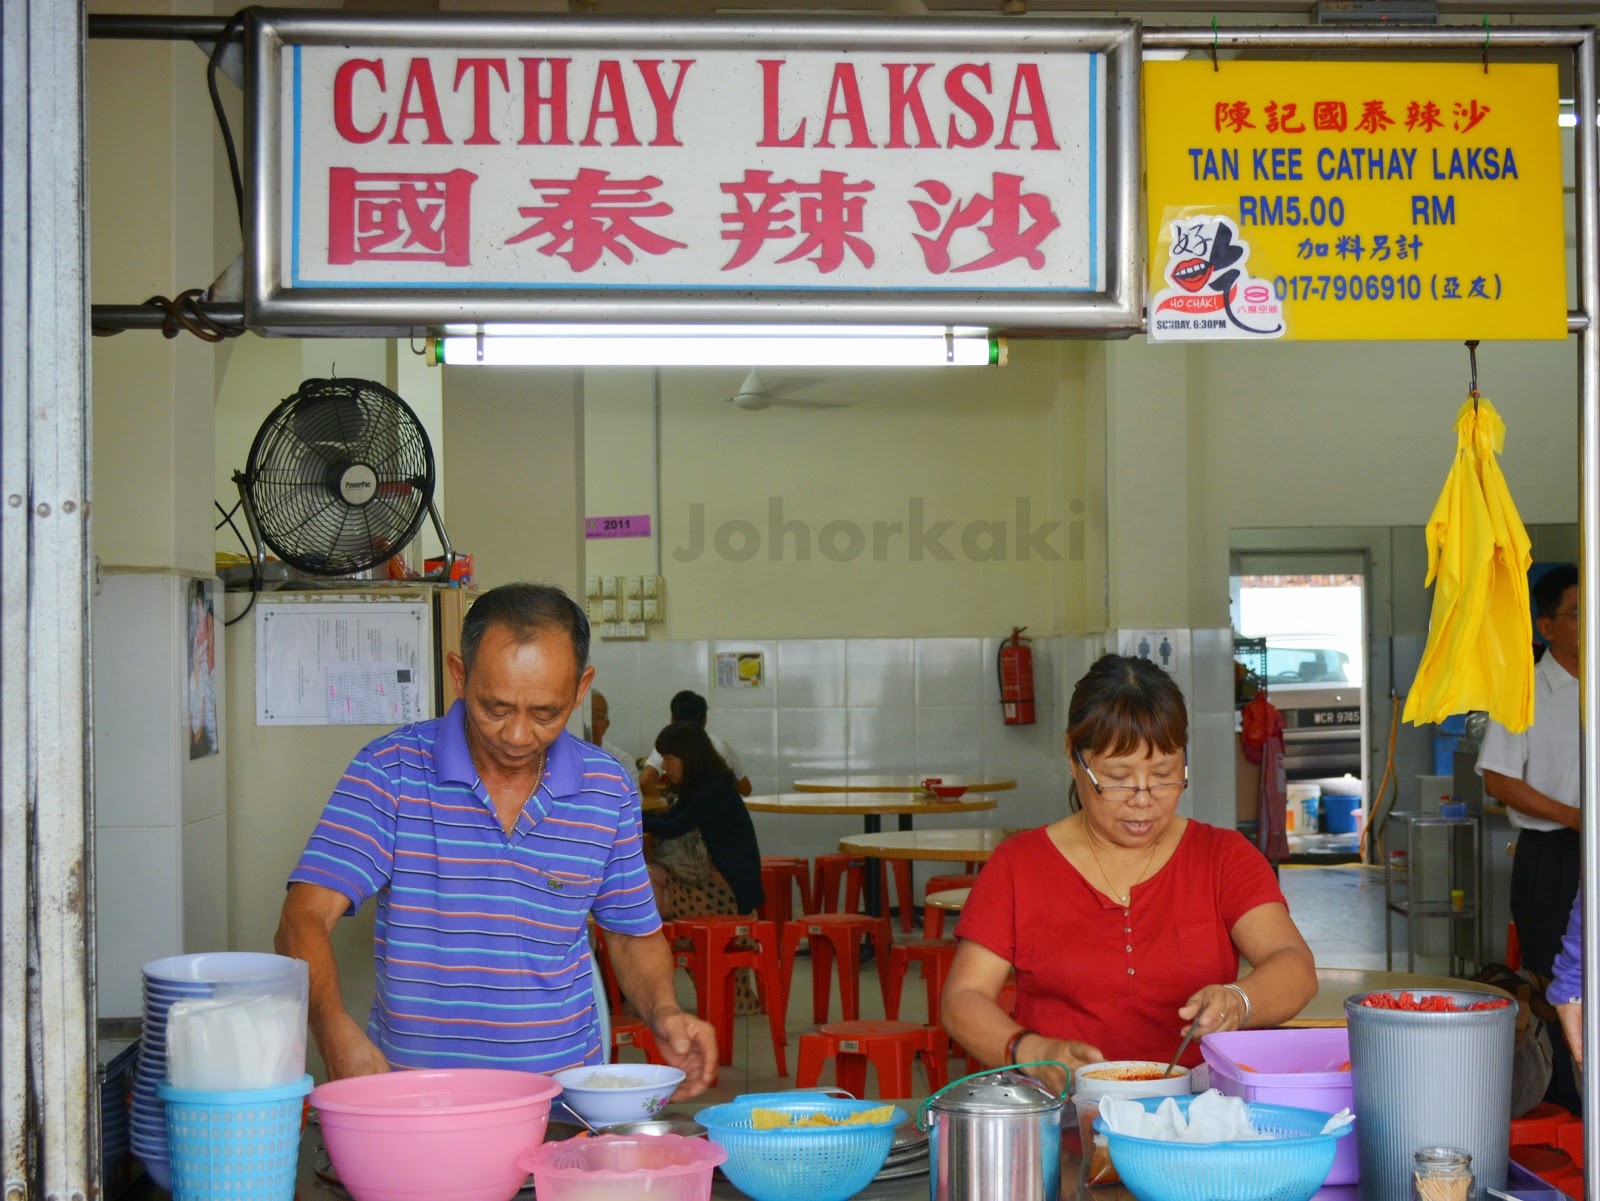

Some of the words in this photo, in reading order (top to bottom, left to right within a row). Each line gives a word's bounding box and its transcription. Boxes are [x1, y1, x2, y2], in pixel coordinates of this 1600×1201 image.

[333, 57, 696, 147] CATHAY
[756, 59, 1061, 150] LAKSA
[1215, 100, 1491, 134] 陳記國泰辣沙
[1189, 148, 1239, 181] TAN
[1254, 148, 1302, 181] KEE
[1317, 147, 1417, 181] CATHAY
[1433, 146, 1519, 180] LAKSA
[328, 166, 1061, 275] 國泰辣沙
[1239, 195, 1345, 227] RM5.00
[1411, 195, 1455, 225] RM
[1297, 234, 1423, 262] 加料另計
[1273, 274, 1421, 301] 017-7906910
[1170, 298, 1183, 308] HO
[1186, 297, 1217, 308] CHAK!
[1193, 320, 1227, 329] 6:30PM
[603, 519, 631, 530] 2011
[1313, 712, 1334, 723] WCR
